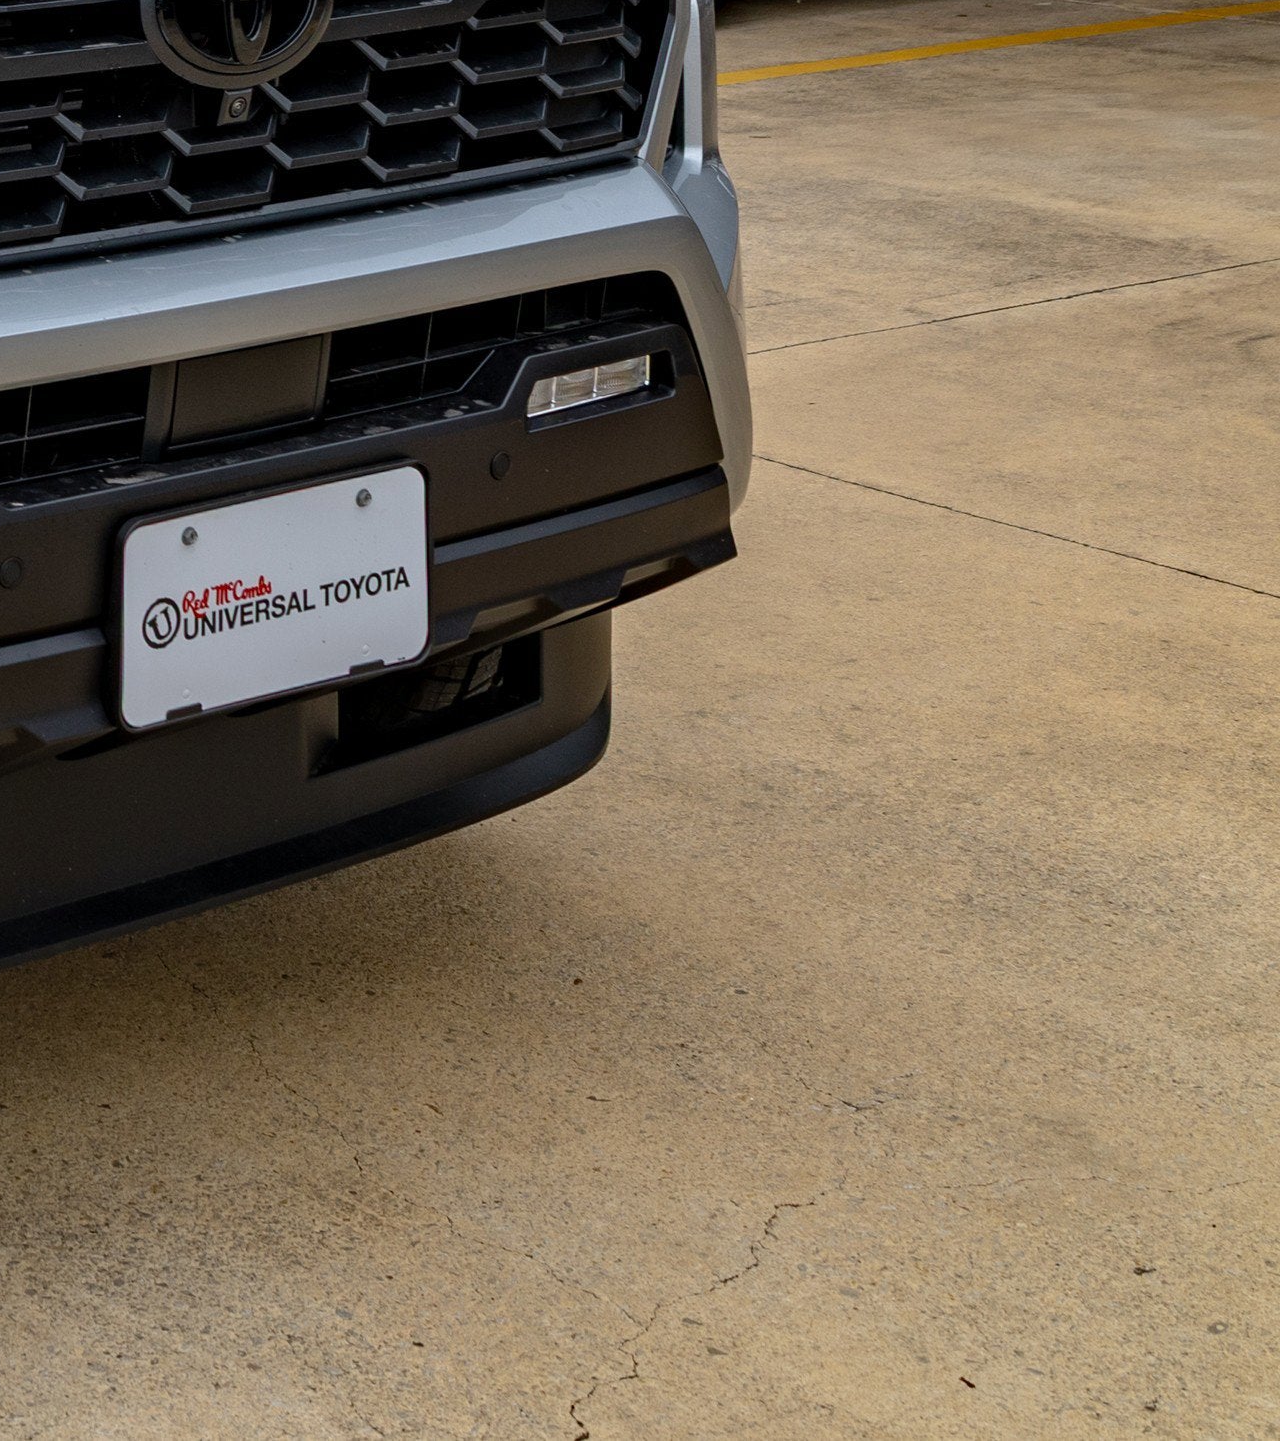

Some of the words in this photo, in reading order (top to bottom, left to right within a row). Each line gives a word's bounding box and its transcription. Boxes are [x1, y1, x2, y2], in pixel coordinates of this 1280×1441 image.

[182, 590, 210, 618] Red
[211, 575, 272, 605] McCombs
[183, 589, 316, 640] UNIVERSAL
[320, 566, 411, 607] TOYOTA
